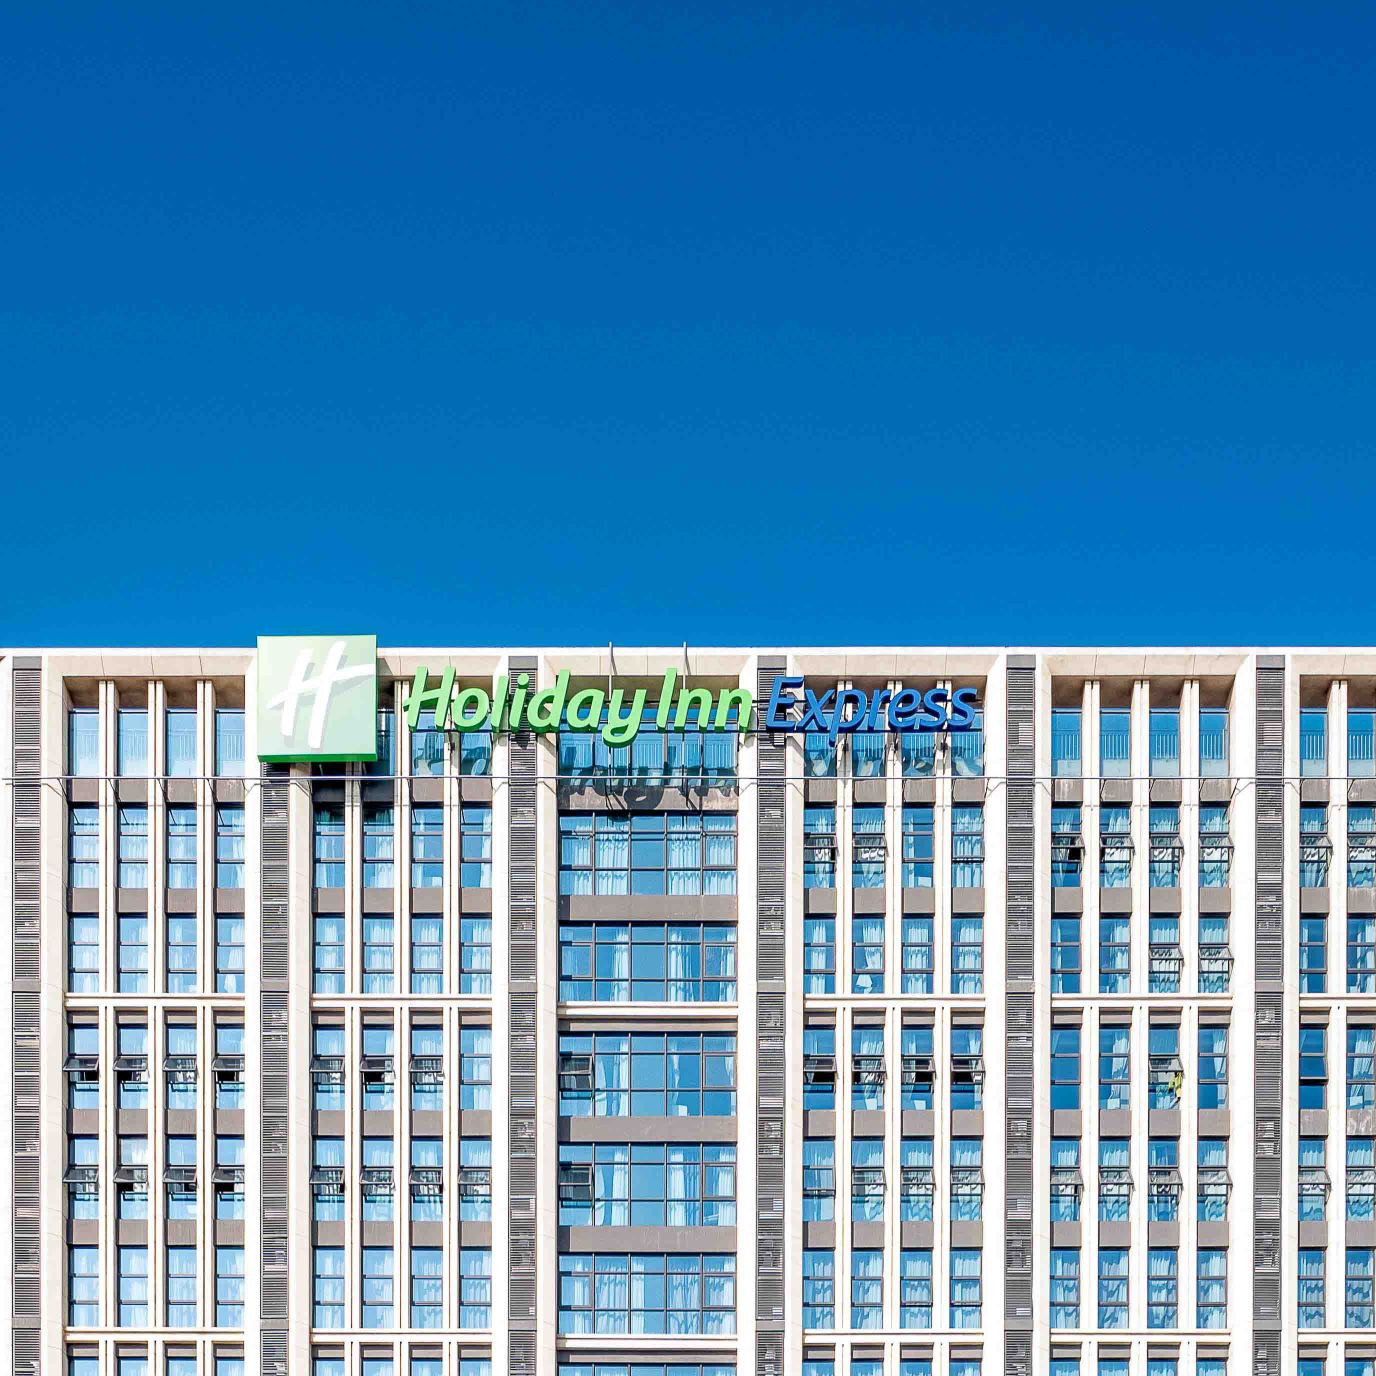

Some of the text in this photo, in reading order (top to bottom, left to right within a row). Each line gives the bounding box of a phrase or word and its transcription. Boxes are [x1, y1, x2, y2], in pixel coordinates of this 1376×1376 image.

[403, 667, 978, 748] Holiday Inn Express
